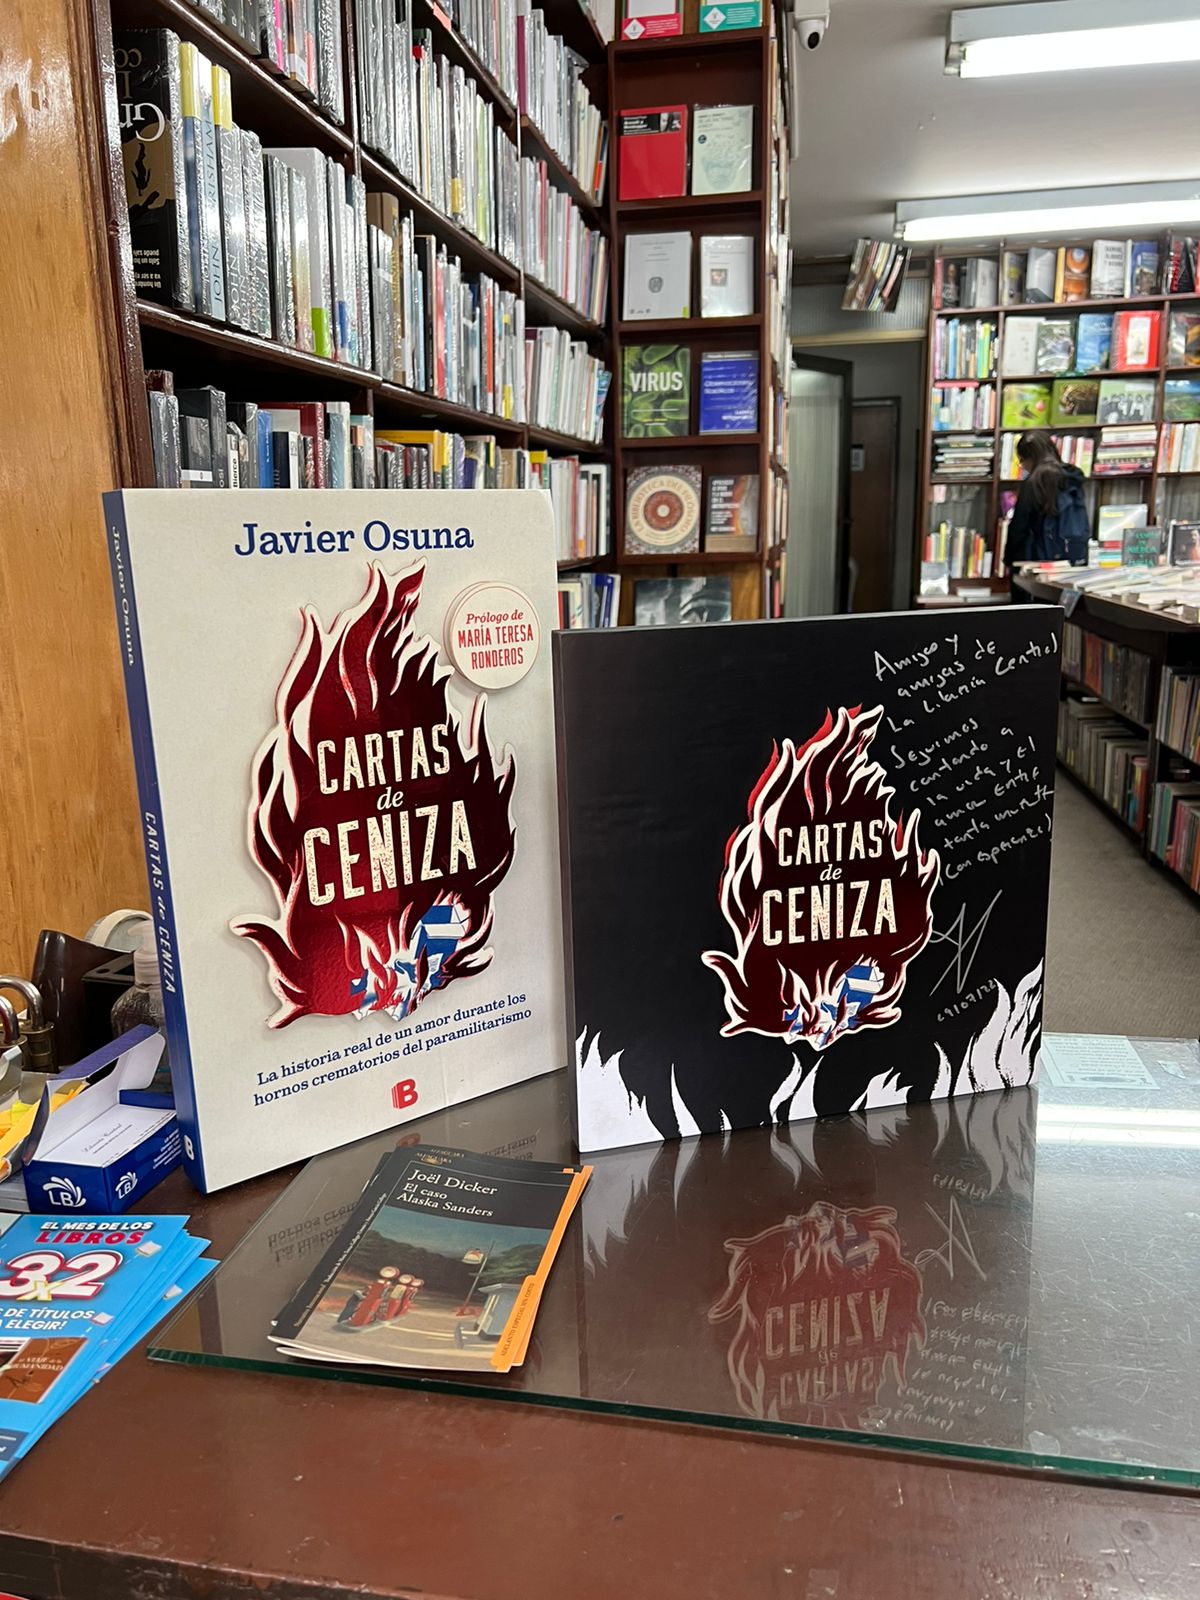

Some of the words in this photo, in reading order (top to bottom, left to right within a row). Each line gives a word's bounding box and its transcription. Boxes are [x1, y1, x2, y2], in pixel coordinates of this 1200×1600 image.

[630, 371, 683, 392] VIRUS
[234, 521, 355, 556] Javier
[363, 520, 474, 551] Osuna
[112, 526, 126, 593] Javier
[122, 598, 134, 666] Osuna
[465, 611, 508, 625] Prólogo
[511, 609, 524, 621] de
[458, 626, 492, 649] MARÍA
[496, 623, 534, 644] TERESA
[471, 647, 524, 670] RONDEROS
[316, 723, 451, 795] CARTAS
[377, 786, 404, 810] de
[145, 811, 165, 890] CARTAS
[303, 800, 477, 907] CENIZA
[778, 819, 883, 867] CARTAS
[819, 864, 842, 881] de
[157, 895, 166, 920] de
[762, 878, 897, 946] CENIZA
[158, 925, 177, 993] CENIZA
[257, 1071, 279, 1085] La
[280, 1050, 341, 1078] historia
[343, 1038, 372, 1057] real
[375, 1031, 392, 1047] de
[395, 1029, 412, 1040] un
[415, 1016, 450, 1034] amor
[453, 1000, 505, 1022] durante
[507, 992, 527, 1007] los
[254, 1080, 309, 1106] hornos
[312, 1050, 400, 1087] crematorios
[402, 1040, 423, 1057] del
[425, 1008, 532, 1050] paramilitarismo
[391, 1078, 418, 1110] B
[183, 1134, 195, 1161] B
[403, 1182, 419, 1193] El
[421, 1189, 447, 1200] caso
[408, 1169, 442, 1185] Joël
[444, 1177, 498, 1195] Dicker
[396, 1192, 439, 1209] Alaska
[443, 1201, 494, 1217] Sanders
[35, 1231, 145, 1245] LIBROS
[40, 1221, 59, 1230] EL
[62, 1222, 96, 1231] MES
[97, 1222, 122, 1231] DE
[123, 1221, 153, 1231] LOS
[4, 1308, 27, 1318] DE
[28, 1307, 95, 1319] TÍTULOS
[5, 1319, 67, 1330] ELEGIR!
